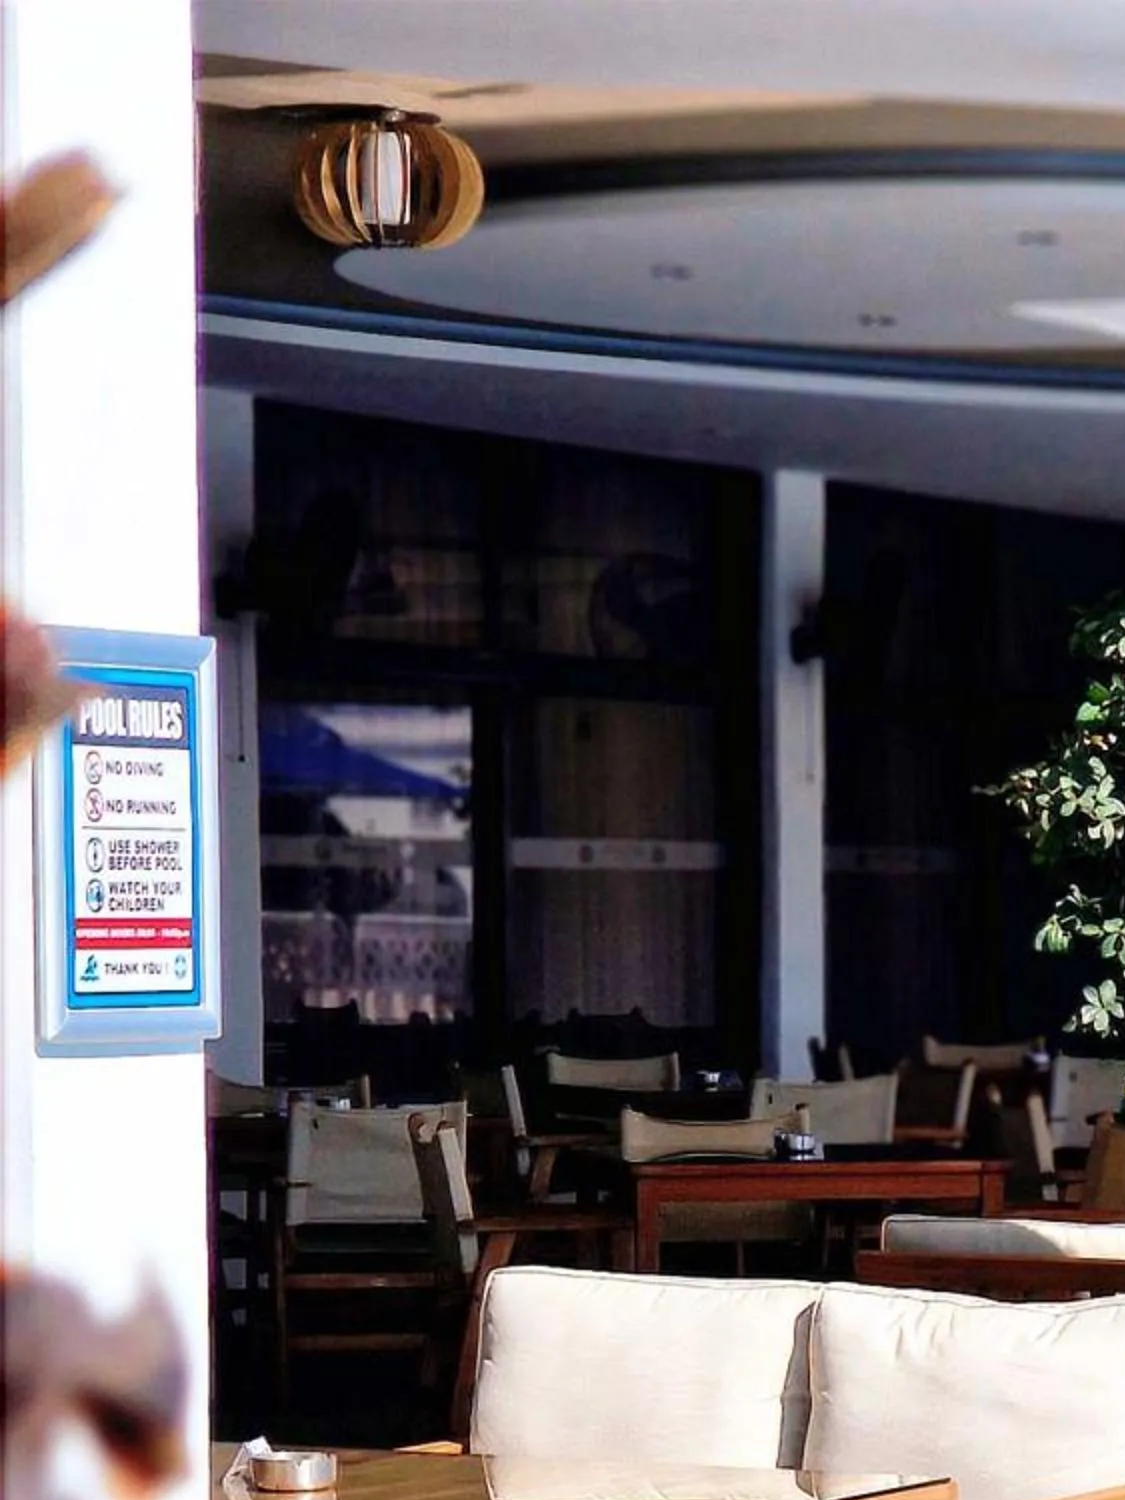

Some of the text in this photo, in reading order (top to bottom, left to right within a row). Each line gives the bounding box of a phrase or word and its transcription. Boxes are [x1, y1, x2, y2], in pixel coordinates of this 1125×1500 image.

[128, 700, 182, 739] RULES
[106, 761, 164, 776] NO DIVING
[106, 800, 176, 815] NO RUNNING
[109, 840, 180, 854] USE SHOWER
[109, 856, 183, 871] BEFORE POOL
[109, 881, 181, 895] WATCH YOUR
[109, 897, 165, 912] CHILDREN
[104, 963, 138, 975] THANK
